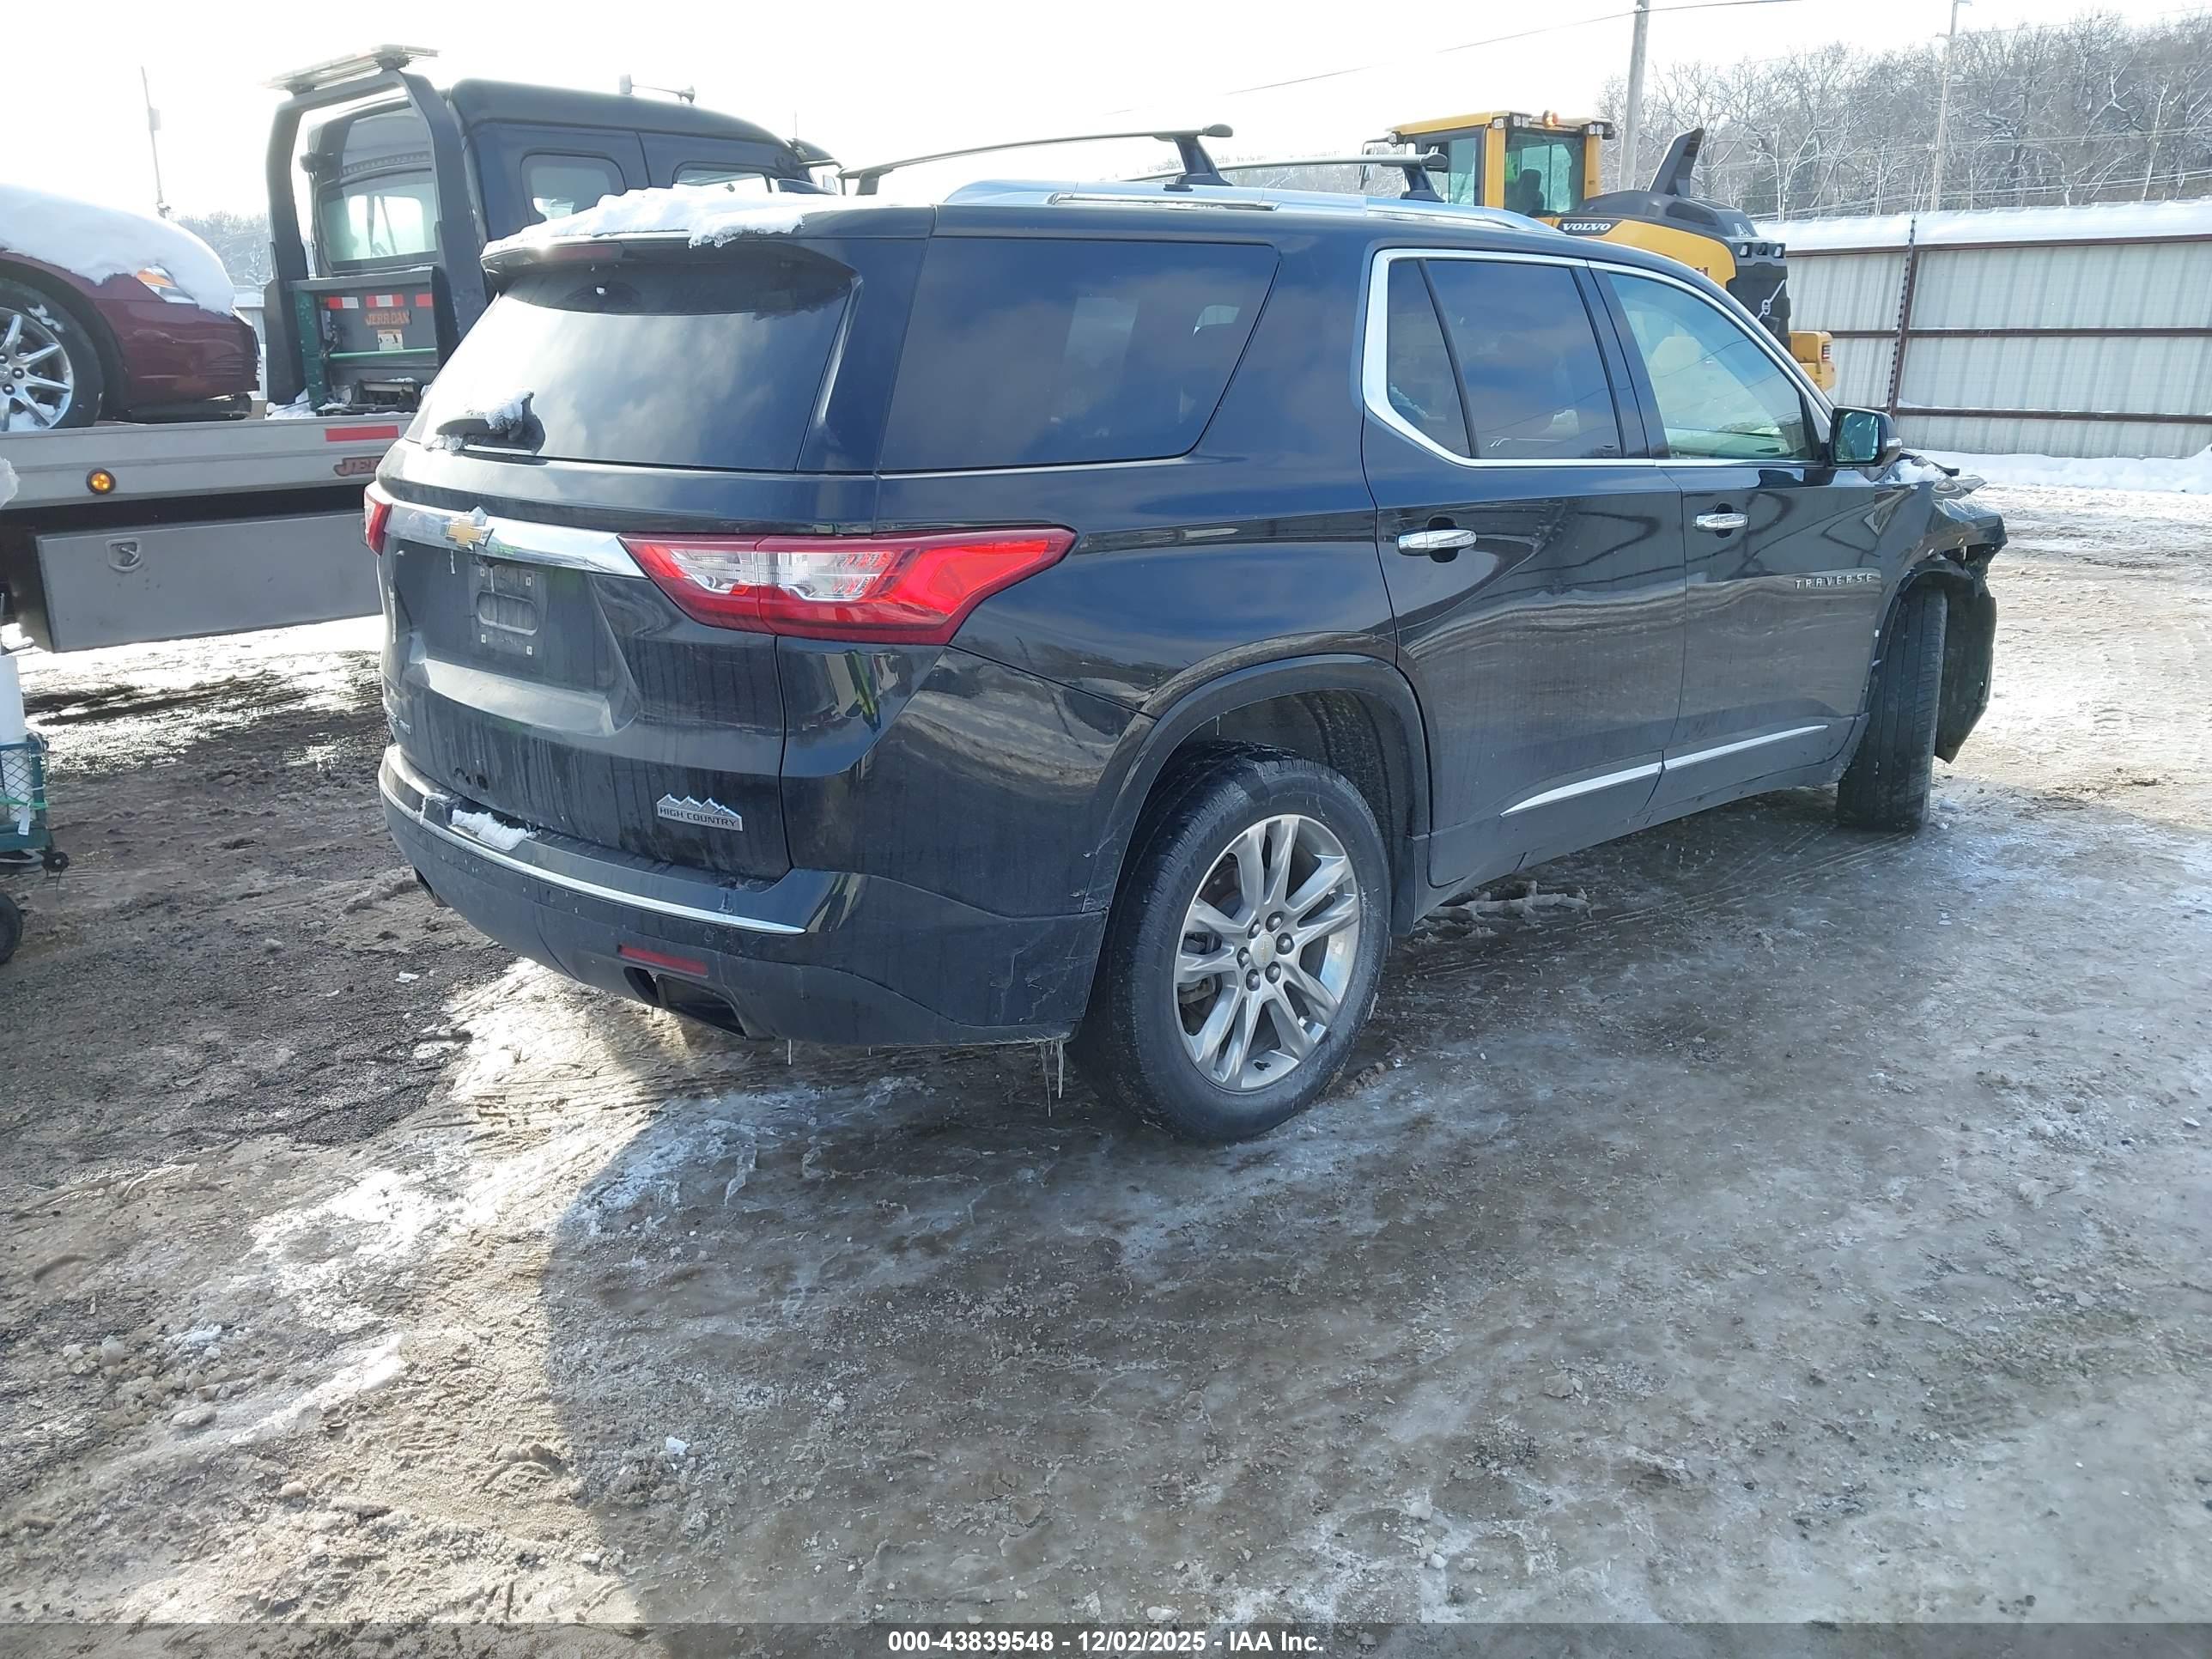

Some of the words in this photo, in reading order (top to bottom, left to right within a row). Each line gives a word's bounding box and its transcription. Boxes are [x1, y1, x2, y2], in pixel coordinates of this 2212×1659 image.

[1563, 222, 1612, 231] VOLVO
[1795, 573, 1873, 589] TRAVERSE
[659, 808, 684, 818] HIGH
[687, 812, 737, 827] COUNTRY
